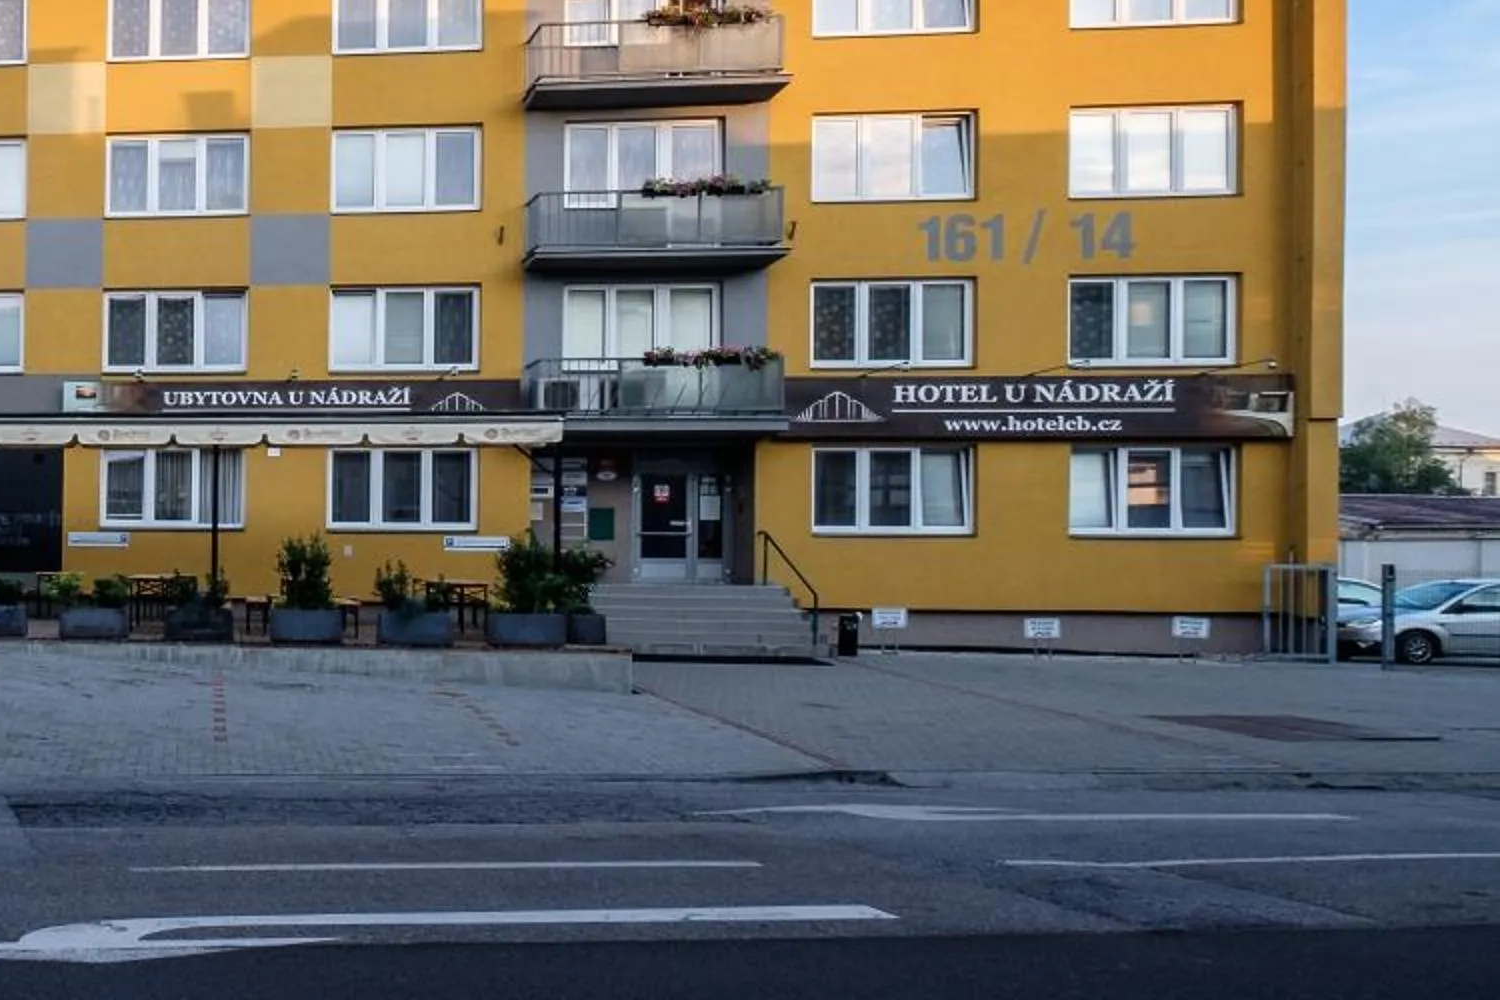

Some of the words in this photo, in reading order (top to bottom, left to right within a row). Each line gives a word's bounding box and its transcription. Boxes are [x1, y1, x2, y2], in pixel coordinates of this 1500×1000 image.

[917, 213, 1004, 262] 161
[1068, 210, 1136, 260] 14
[162, 390, 284, 406] UBYTOVNA
[289, 390, 305, 406] U
[309, 386, 411, 406] NÁDRAŽÍ
[892, 384, 998, 403] HOTEL
[1004, 384, 1028, 403] U
[1033, 379, 1176, 403] NÁDRAŽÍ
[943, 415, 1123, 432] www.hotelcb.cz
